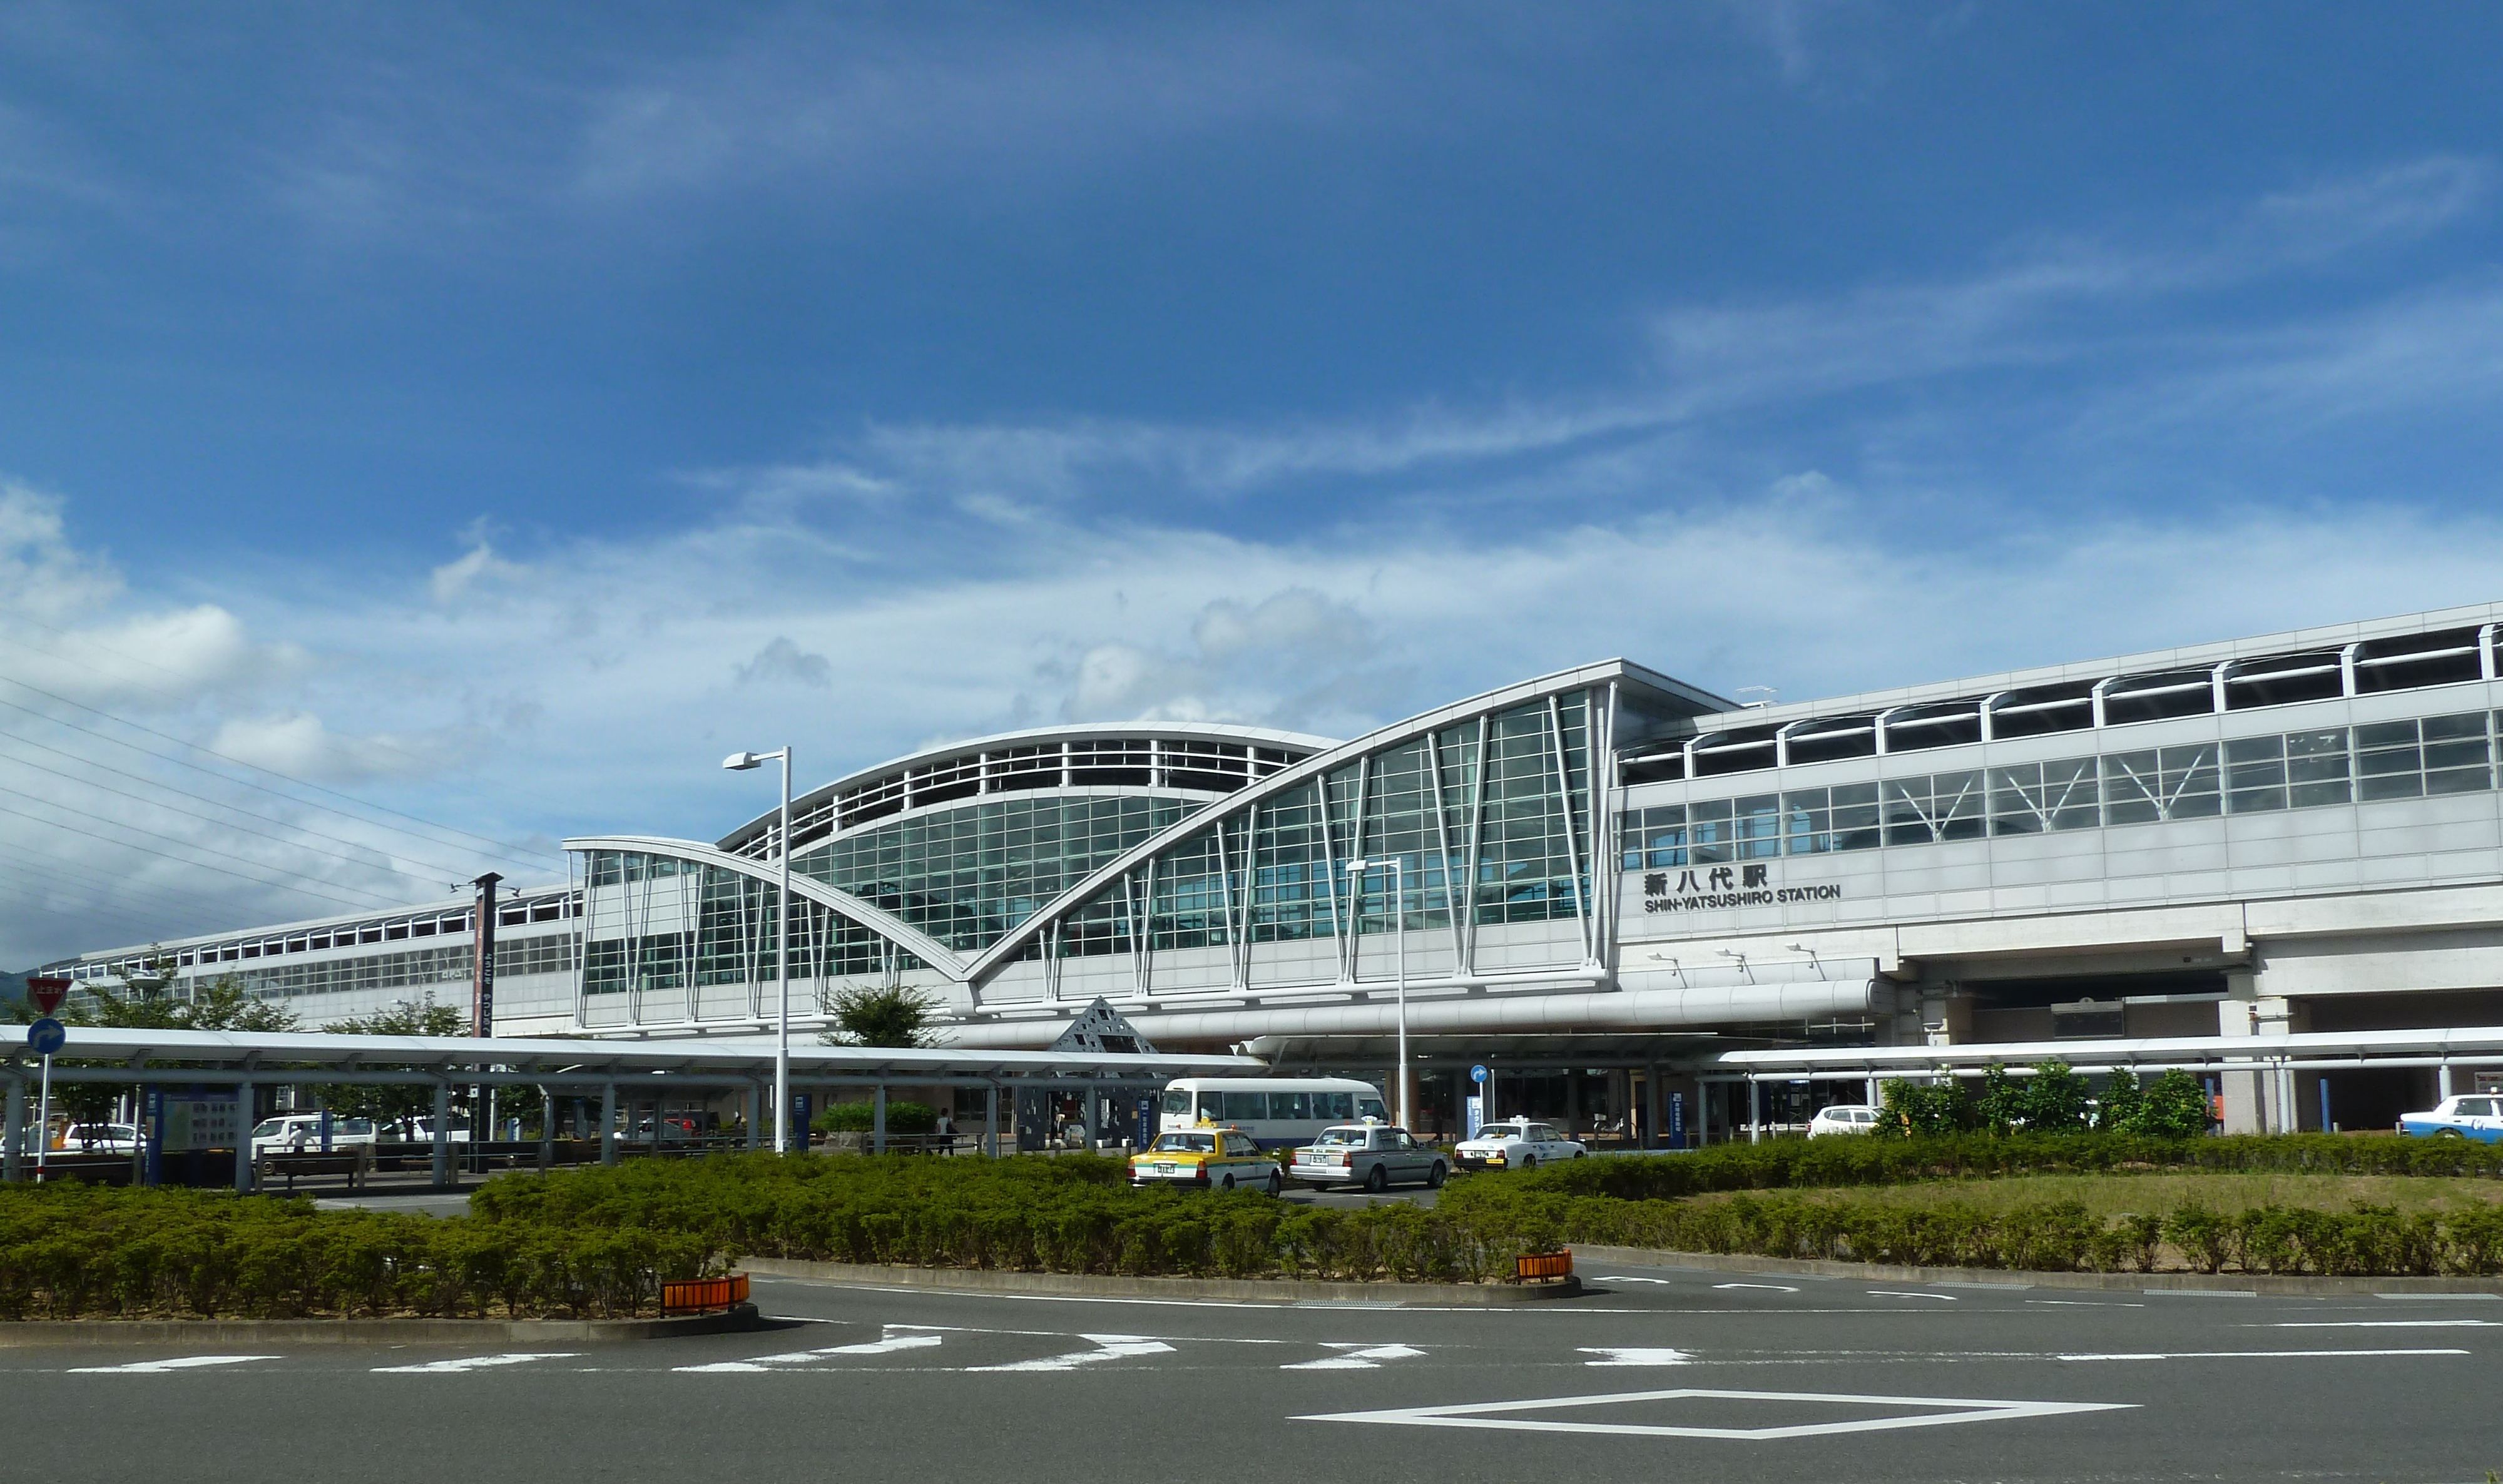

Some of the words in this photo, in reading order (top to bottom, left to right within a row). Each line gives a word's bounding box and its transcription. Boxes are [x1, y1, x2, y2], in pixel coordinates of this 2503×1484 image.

[1644, 864, 1767, 897] 新八代駅
[1644, 890, 1773, 913] SHIN-YATSUSHIRO
[1777, 885, 1841, 903] STATION
[36, 985, 63, 994] 止まれ
[483, 994, 491, 1032] やつしろへ
